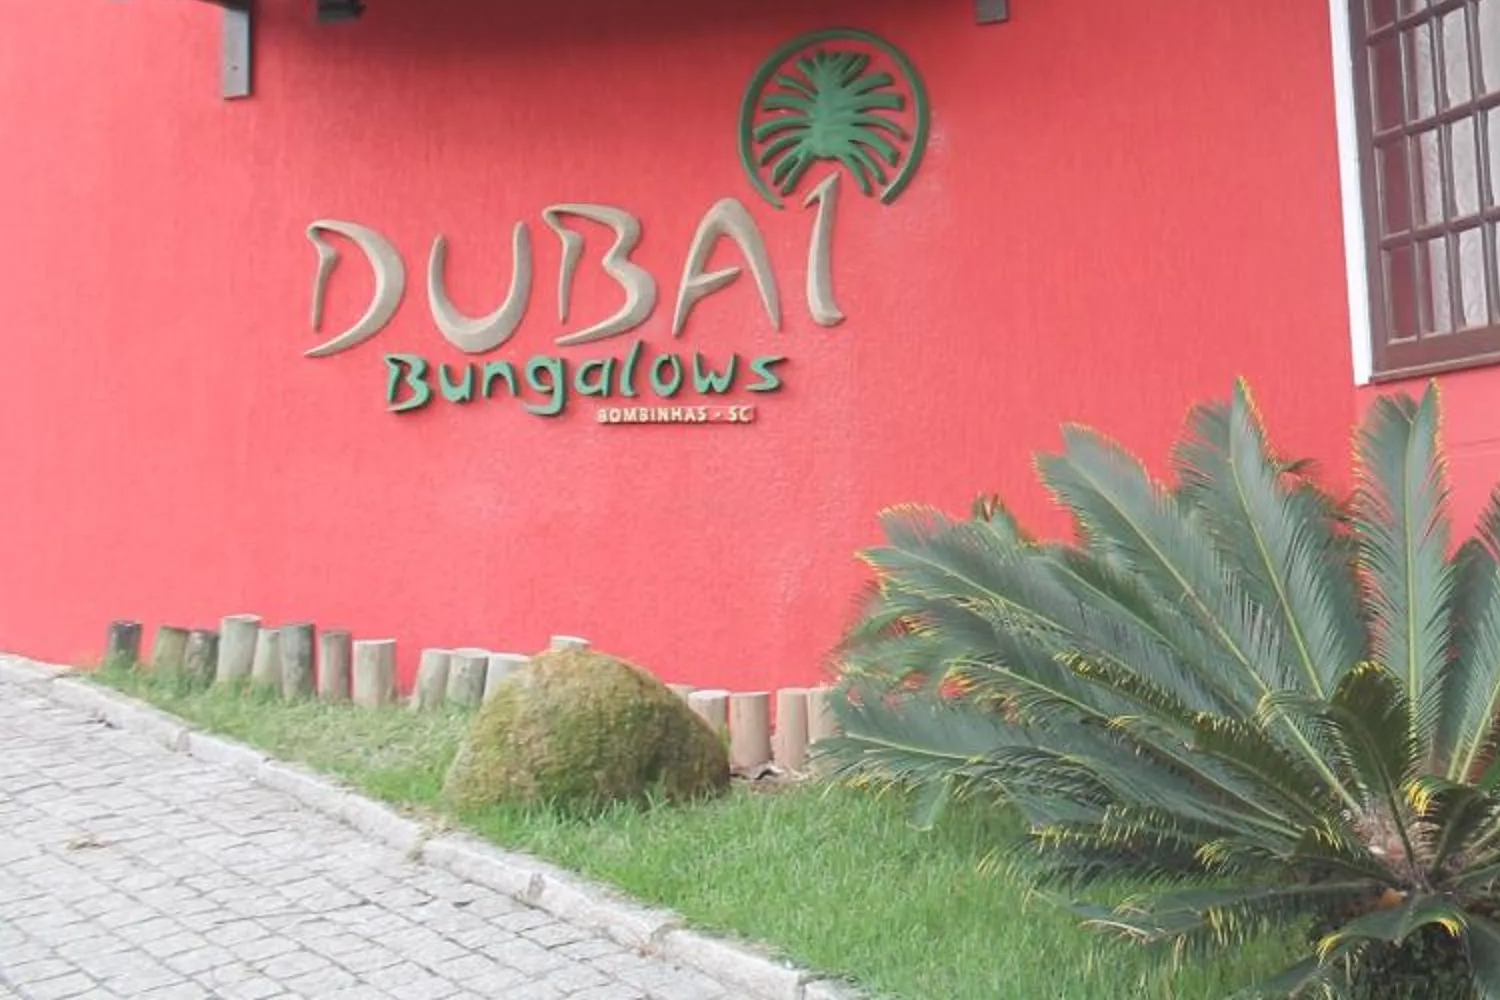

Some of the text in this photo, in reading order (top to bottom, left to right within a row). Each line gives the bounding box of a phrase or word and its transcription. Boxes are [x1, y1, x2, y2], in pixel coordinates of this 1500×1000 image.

[304, 171, 845, 357] DUBAI
[383, 341, 789, 417] Bungalows
[597, 406, 707, 423] BOMBINHAS
[728, 406, 750, 422] SC
